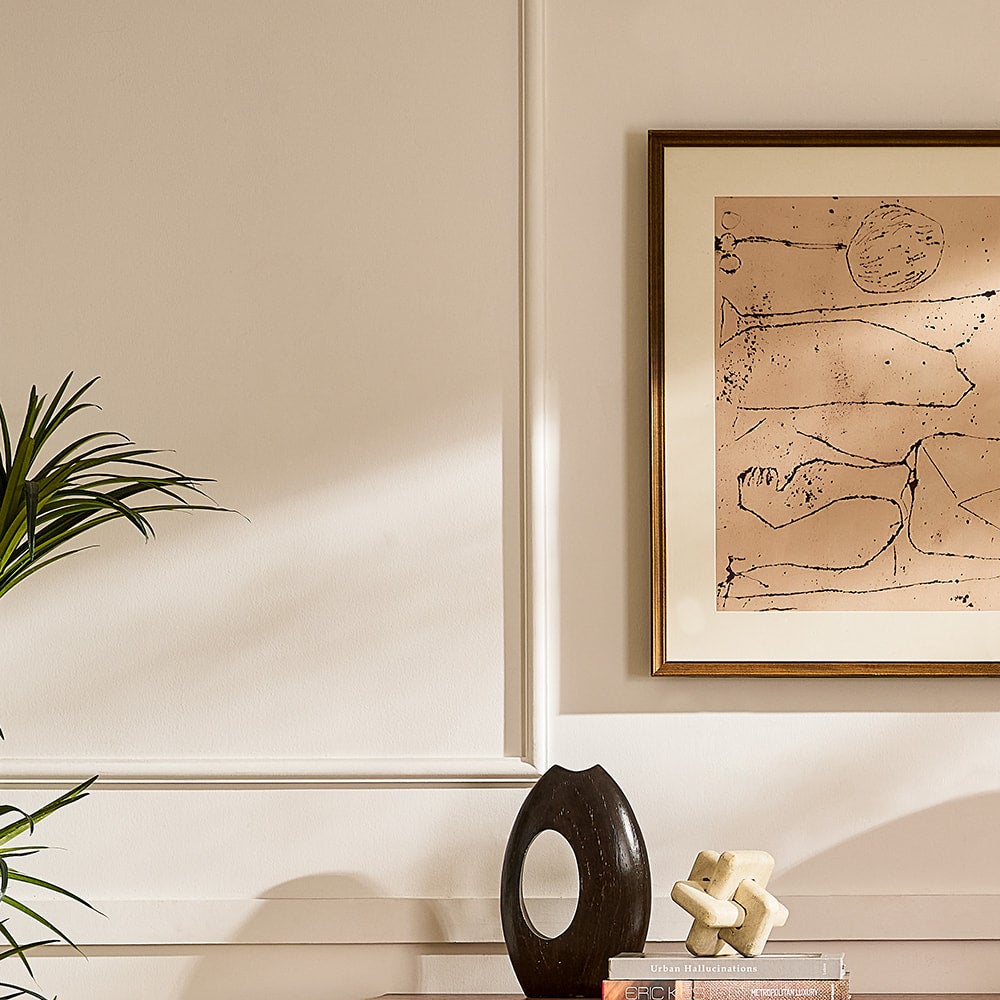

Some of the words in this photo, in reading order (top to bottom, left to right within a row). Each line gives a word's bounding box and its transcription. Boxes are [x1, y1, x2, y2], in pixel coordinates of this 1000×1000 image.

[650, 964, 681, 973] Urban
[684, 964, 758, 973] Hallucinations
[625, 986, 664, 1000] ERIC
[751, 988, 794, 997] METROPOLITAN
